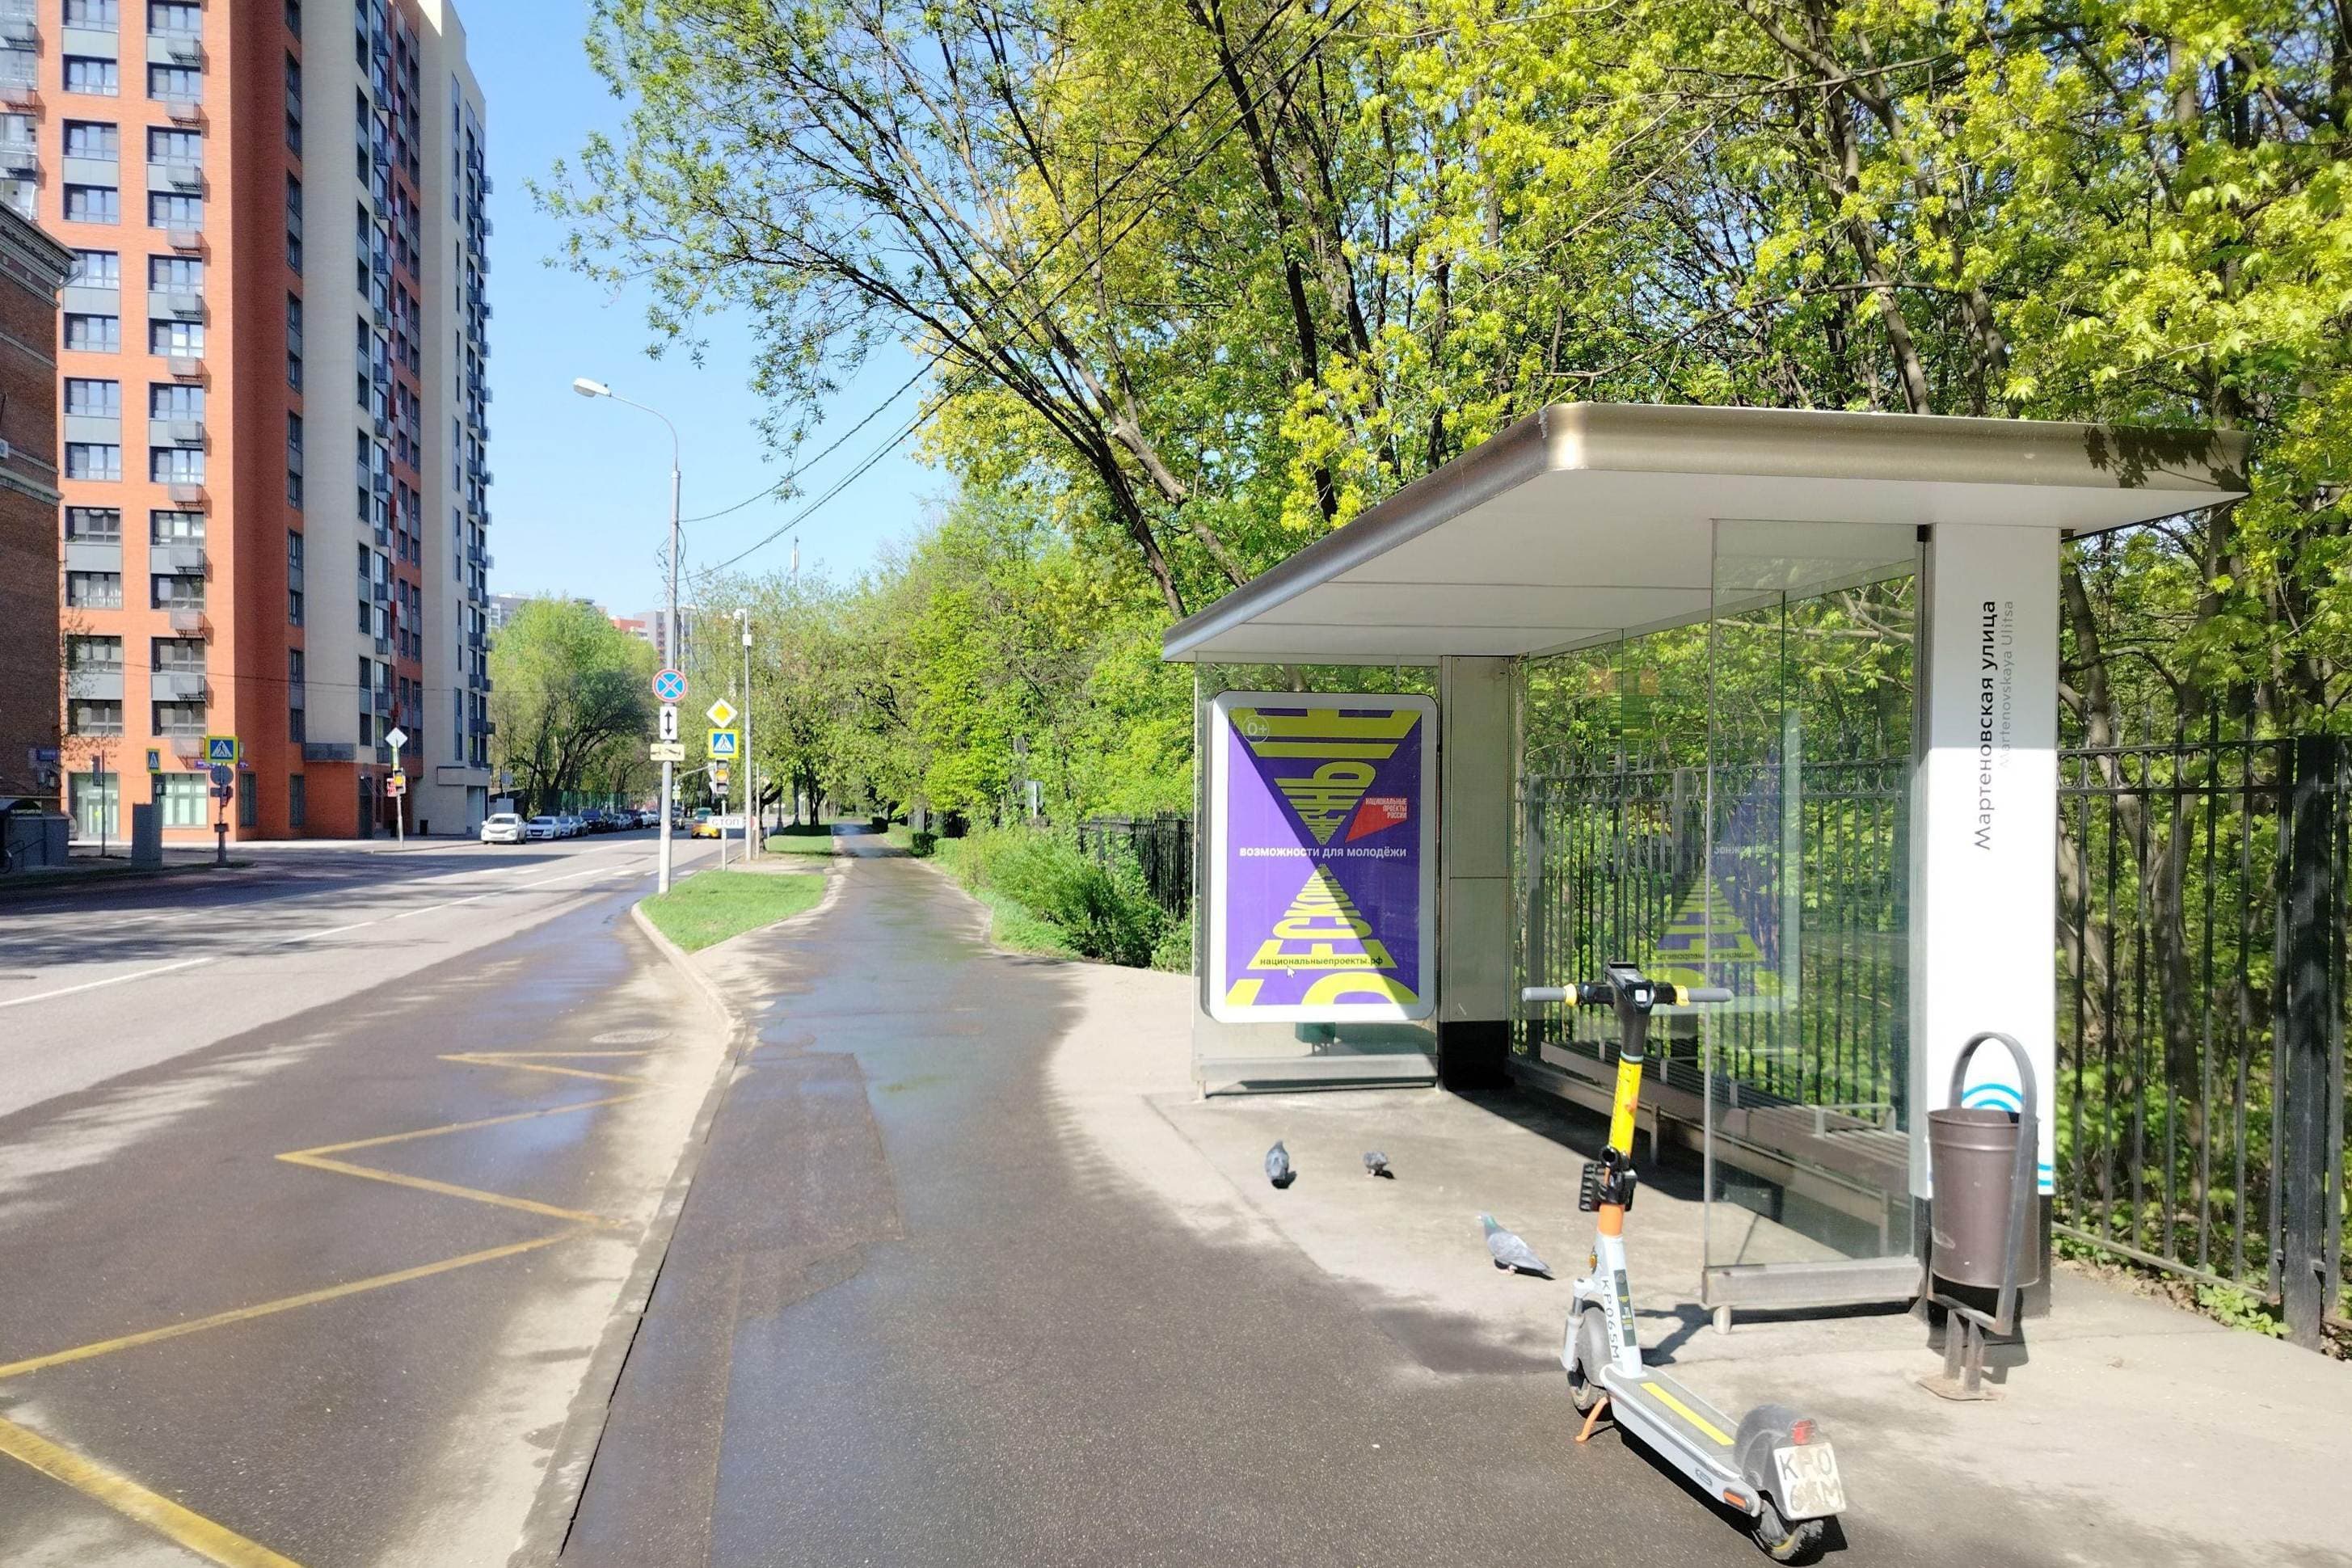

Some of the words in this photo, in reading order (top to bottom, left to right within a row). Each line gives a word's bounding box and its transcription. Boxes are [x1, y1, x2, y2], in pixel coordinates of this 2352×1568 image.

[1982, 601, 1998, 670] улица
[2000, 601, 2014, 646] Ulitsa
[1999, 651, 2016, 769] Martenovskaya
[1974, 677, 1995, 850] Мартеновская
[1260, 955, 1384, 967] национальныепроекты.рф
